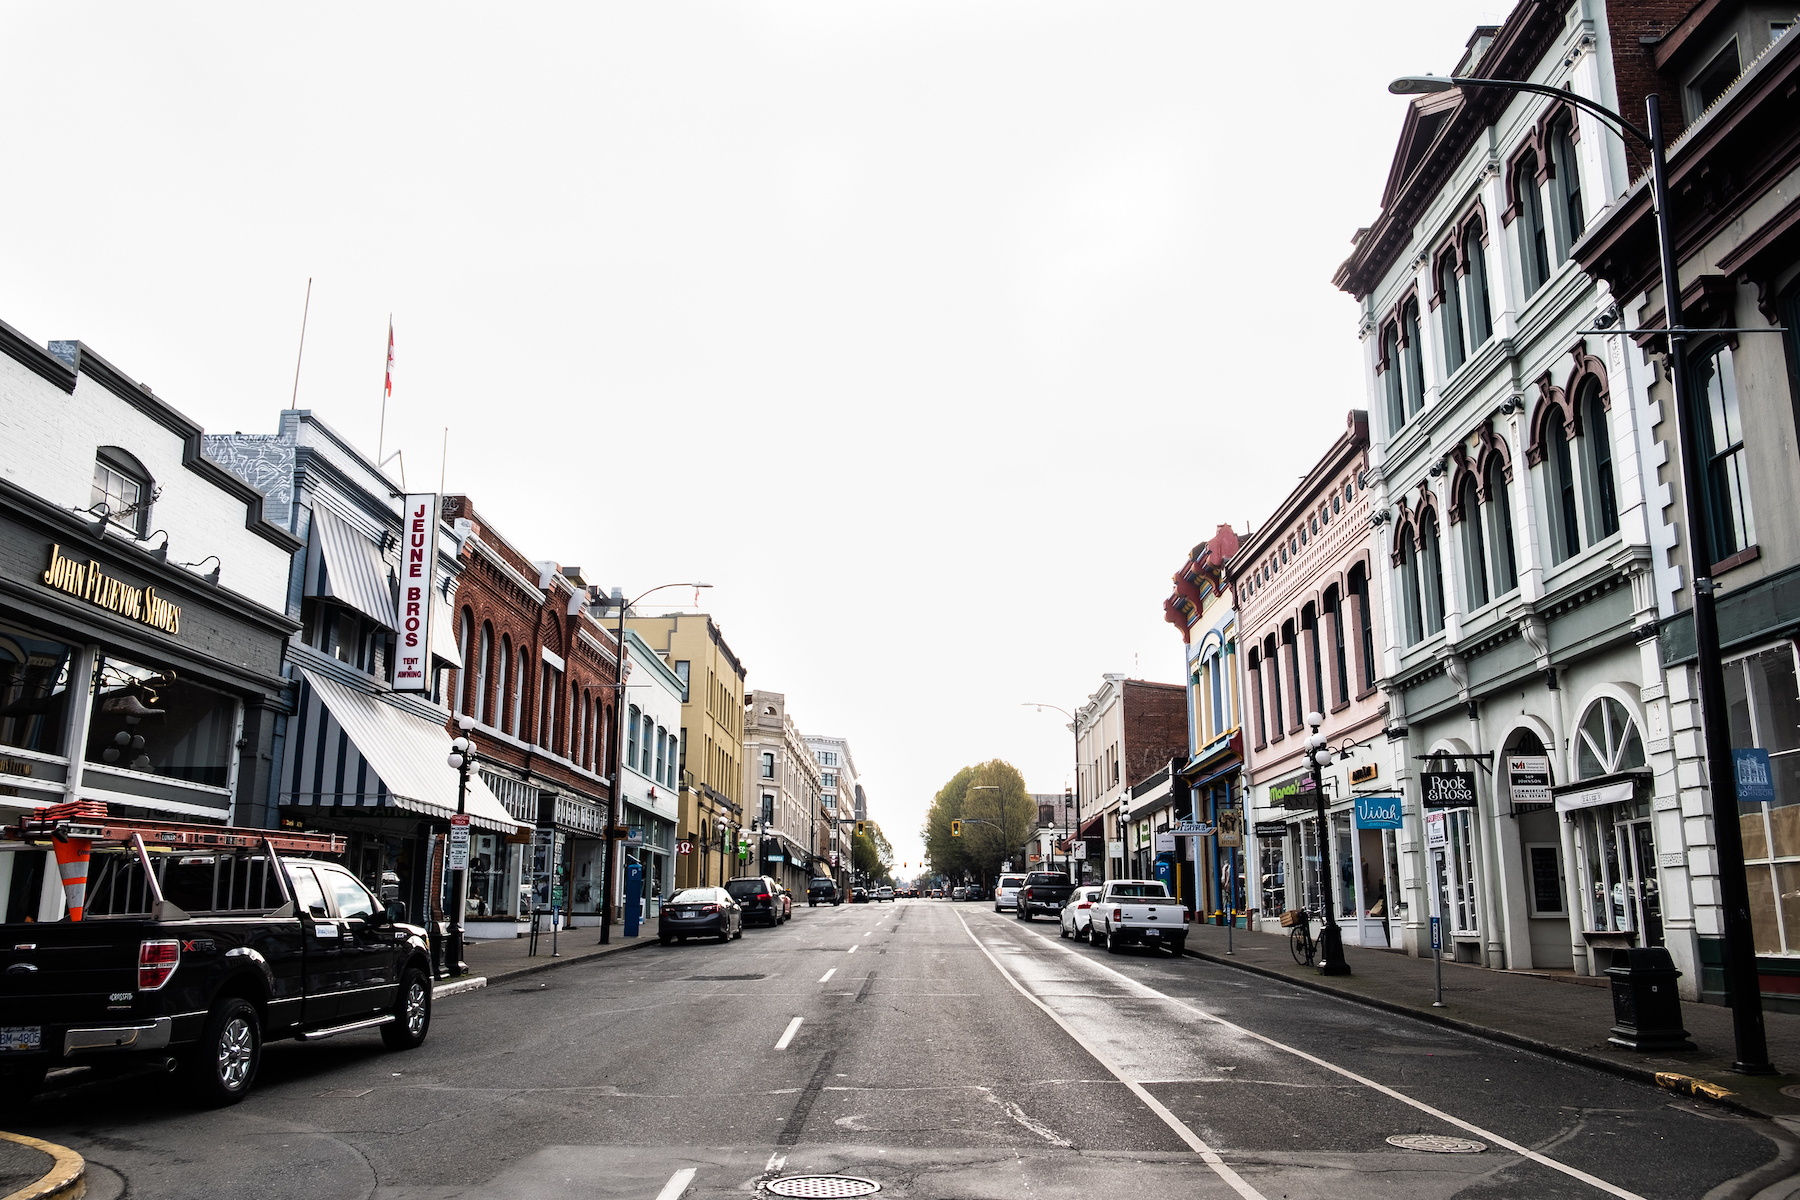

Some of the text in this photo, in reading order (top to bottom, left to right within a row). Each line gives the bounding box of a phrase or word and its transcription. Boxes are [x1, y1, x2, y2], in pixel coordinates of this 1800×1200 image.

[405, 504, 425, 647] JEUNE BROS
[44, 543, 182, 635] JOHN FLUEVOG SHOES
[403, 657, 419, 665] TENT
[397, 670, 422, 678] AWNING
[1431, 776, 1467, 790] Rook
[1357, 800, 1400, 820] Vivah
[182, 938, 217, 953] XTR
